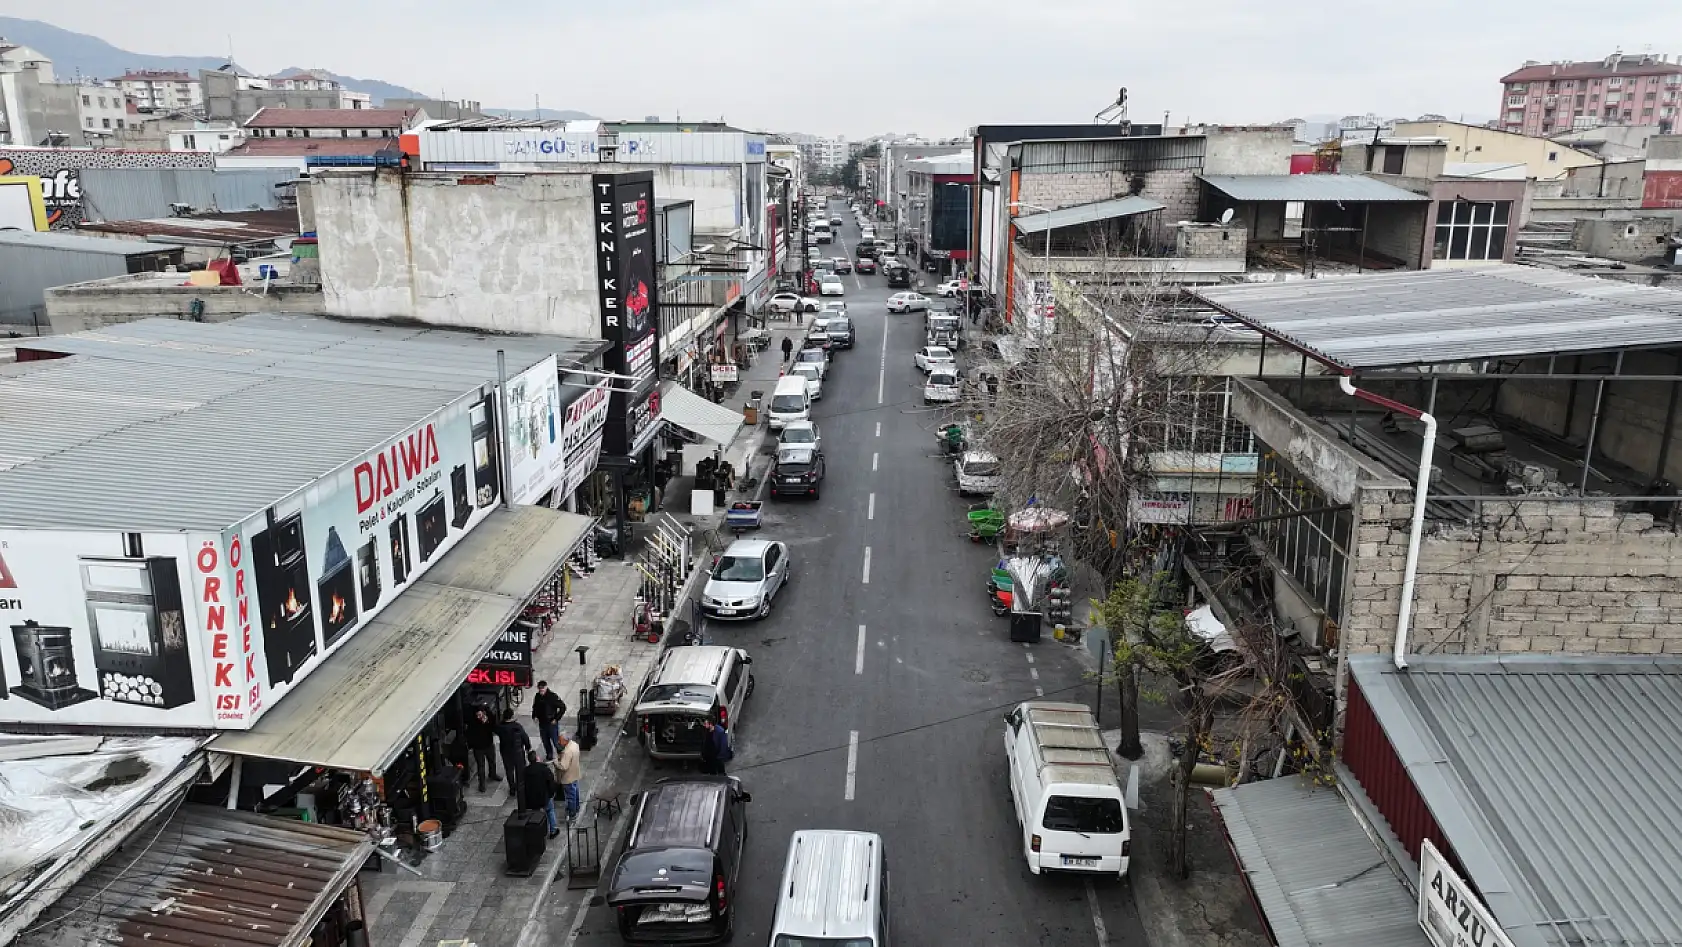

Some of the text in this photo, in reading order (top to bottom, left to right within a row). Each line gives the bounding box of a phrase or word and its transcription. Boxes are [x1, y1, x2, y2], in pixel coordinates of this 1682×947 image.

[597, 183, 618, 327] TEKNİKER
[354, 423, 440, 515] DAIWA
[359, 511, 380, 534] Pelet
[197, 541, 234, 687] ÖRNEK
[230, 533, 255, 683] ÖRNEK
[216, 694, 241, 710] ISI
[495, 670, 516, 683] ISI
[1431, 870, 1487, 947] ARZU
